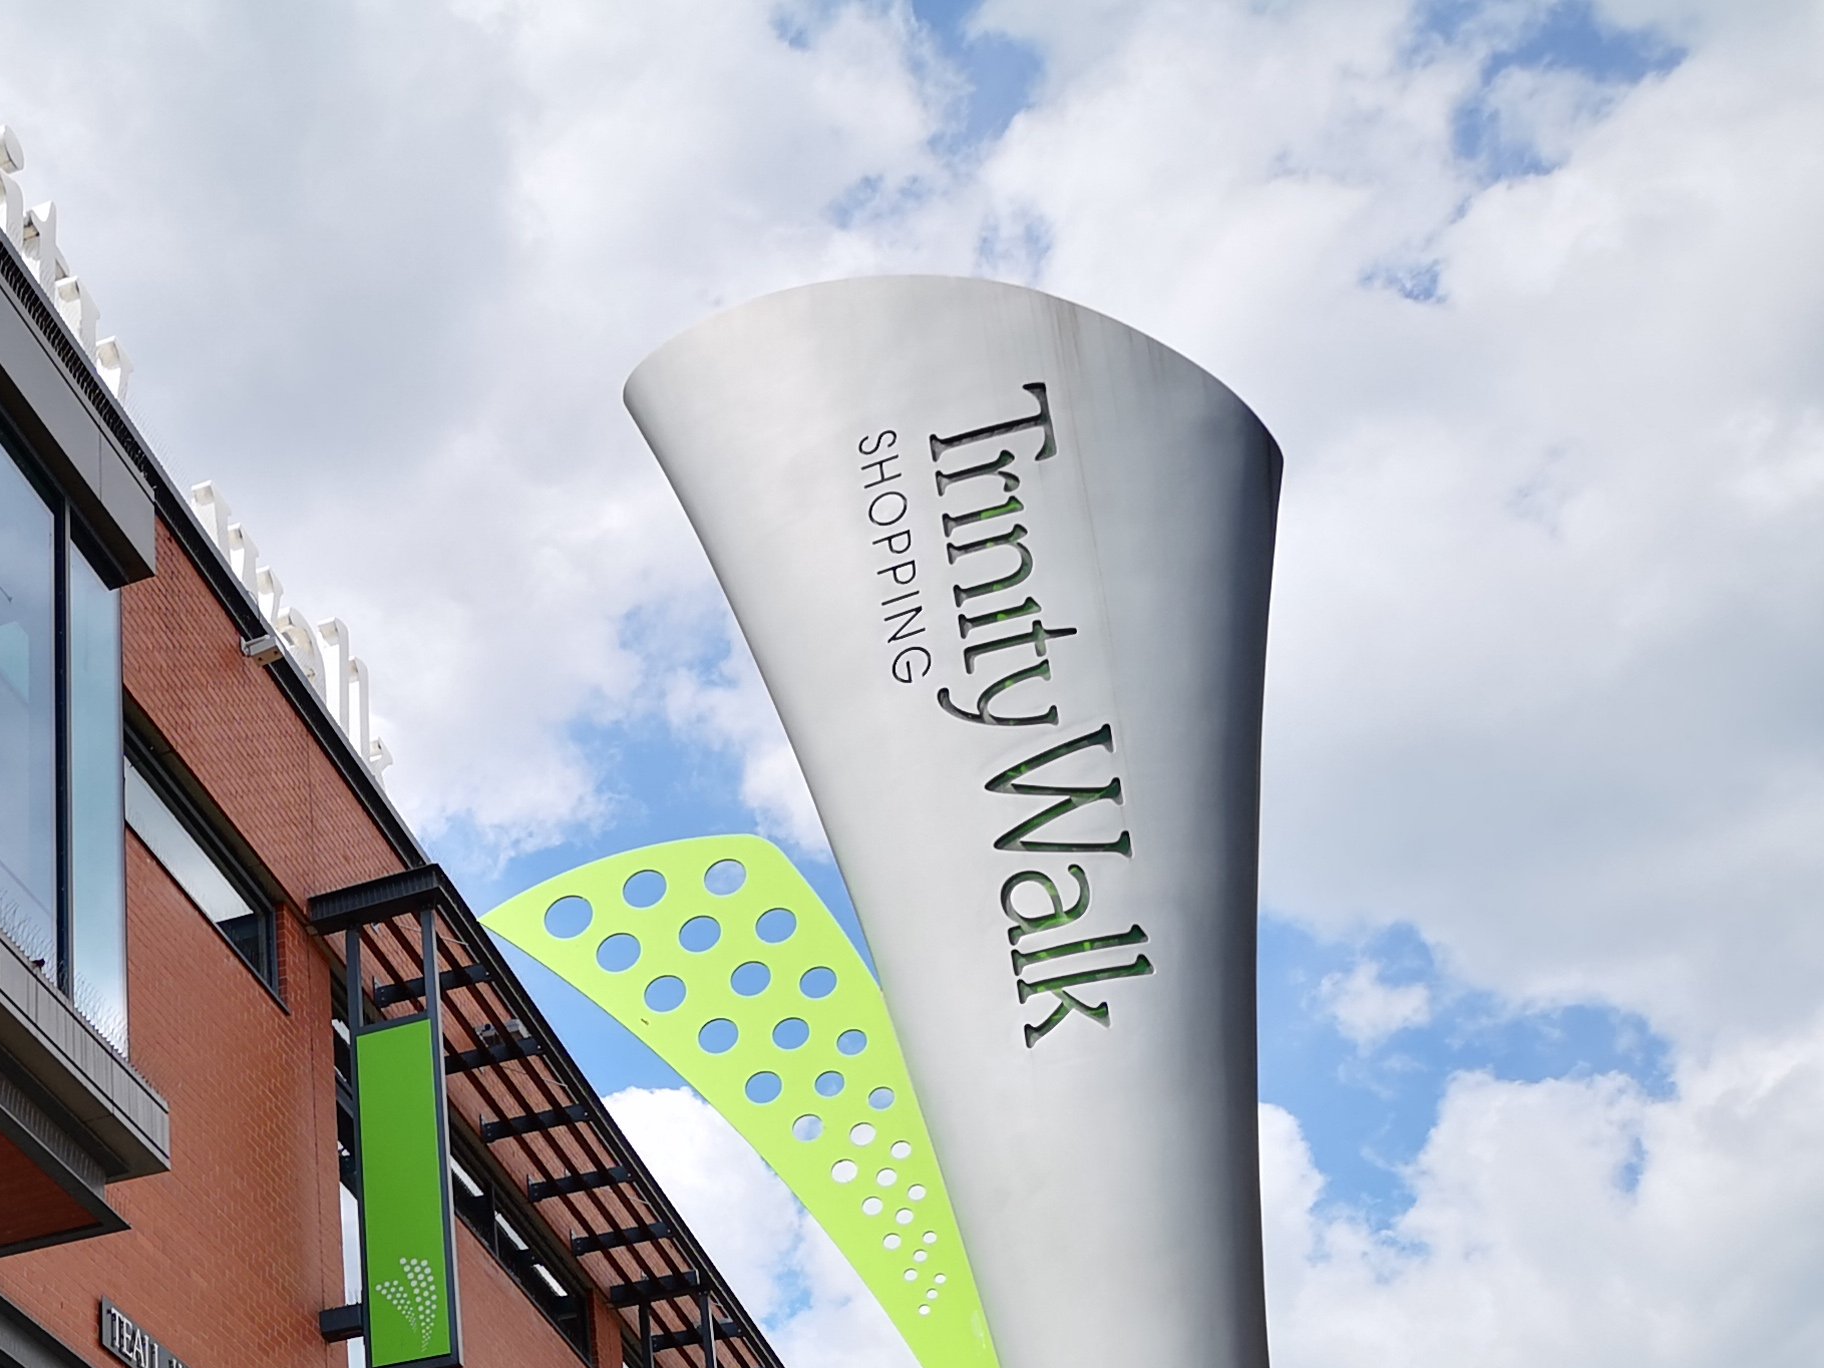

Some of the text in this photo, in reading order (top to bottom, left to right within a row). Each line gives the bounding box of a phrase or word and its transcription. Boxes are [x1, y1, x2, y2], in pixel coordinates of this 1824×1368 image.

[858, 429, 932, 686] SHOPPING
[929, 381, 1155, 1048] Trinity Walk
